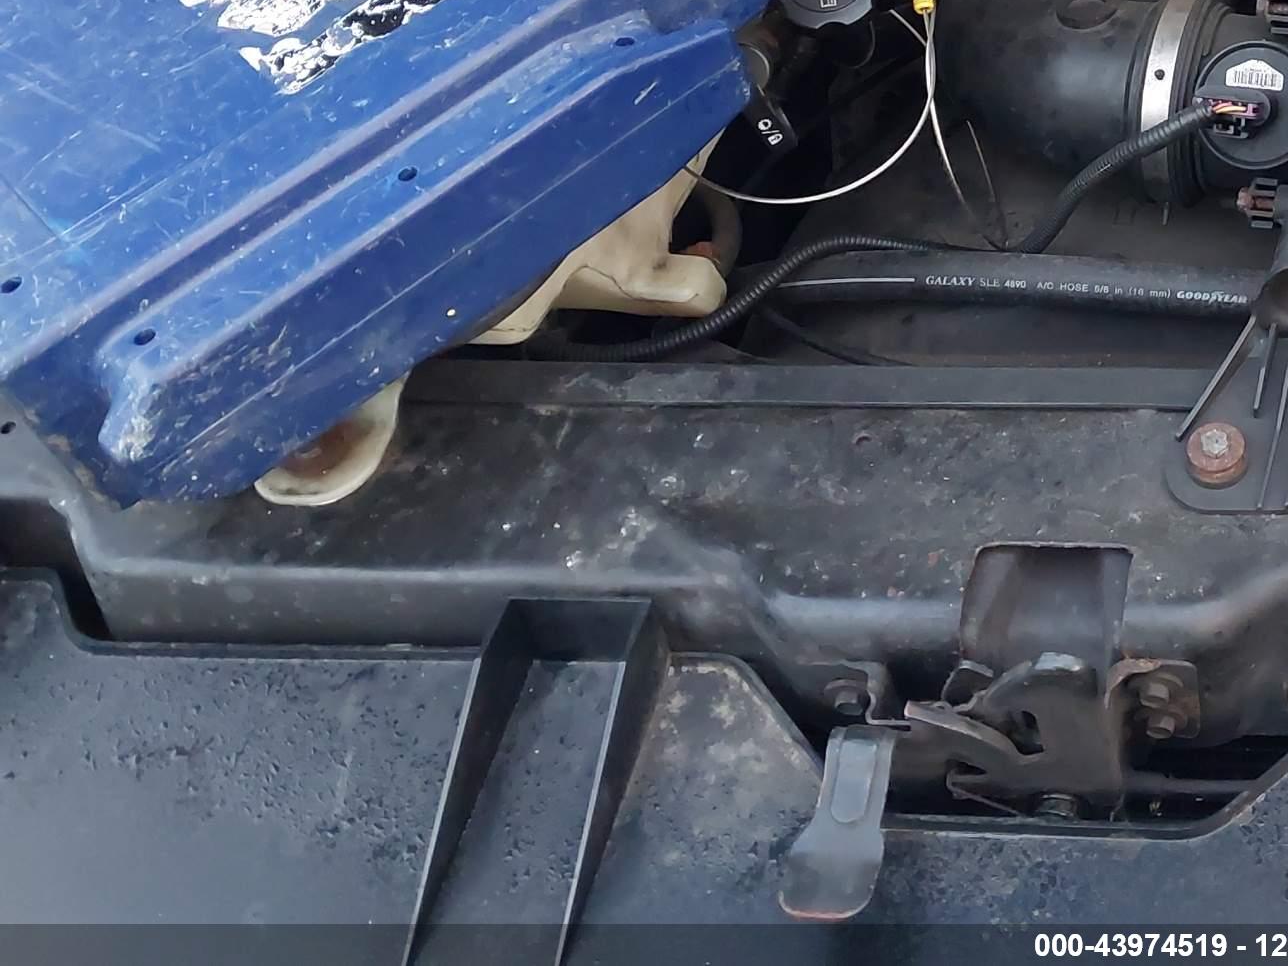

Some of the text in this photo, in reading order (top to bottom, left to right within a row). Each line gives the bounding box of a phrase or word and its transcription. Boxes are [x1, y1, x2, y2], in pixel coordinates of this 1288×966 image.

[925, 275, 975, 287] GALAXY
[979, 278, 1000, 287] SLE
[1036, 281, 1054, 290] A/C
[1059, 283, 1089, 293] HOSE
[1114, 286, 1123, 295] in
[1148, 288, 1171, 299] mm)
[1176, 289, 1248, 305] GOODYEAR
